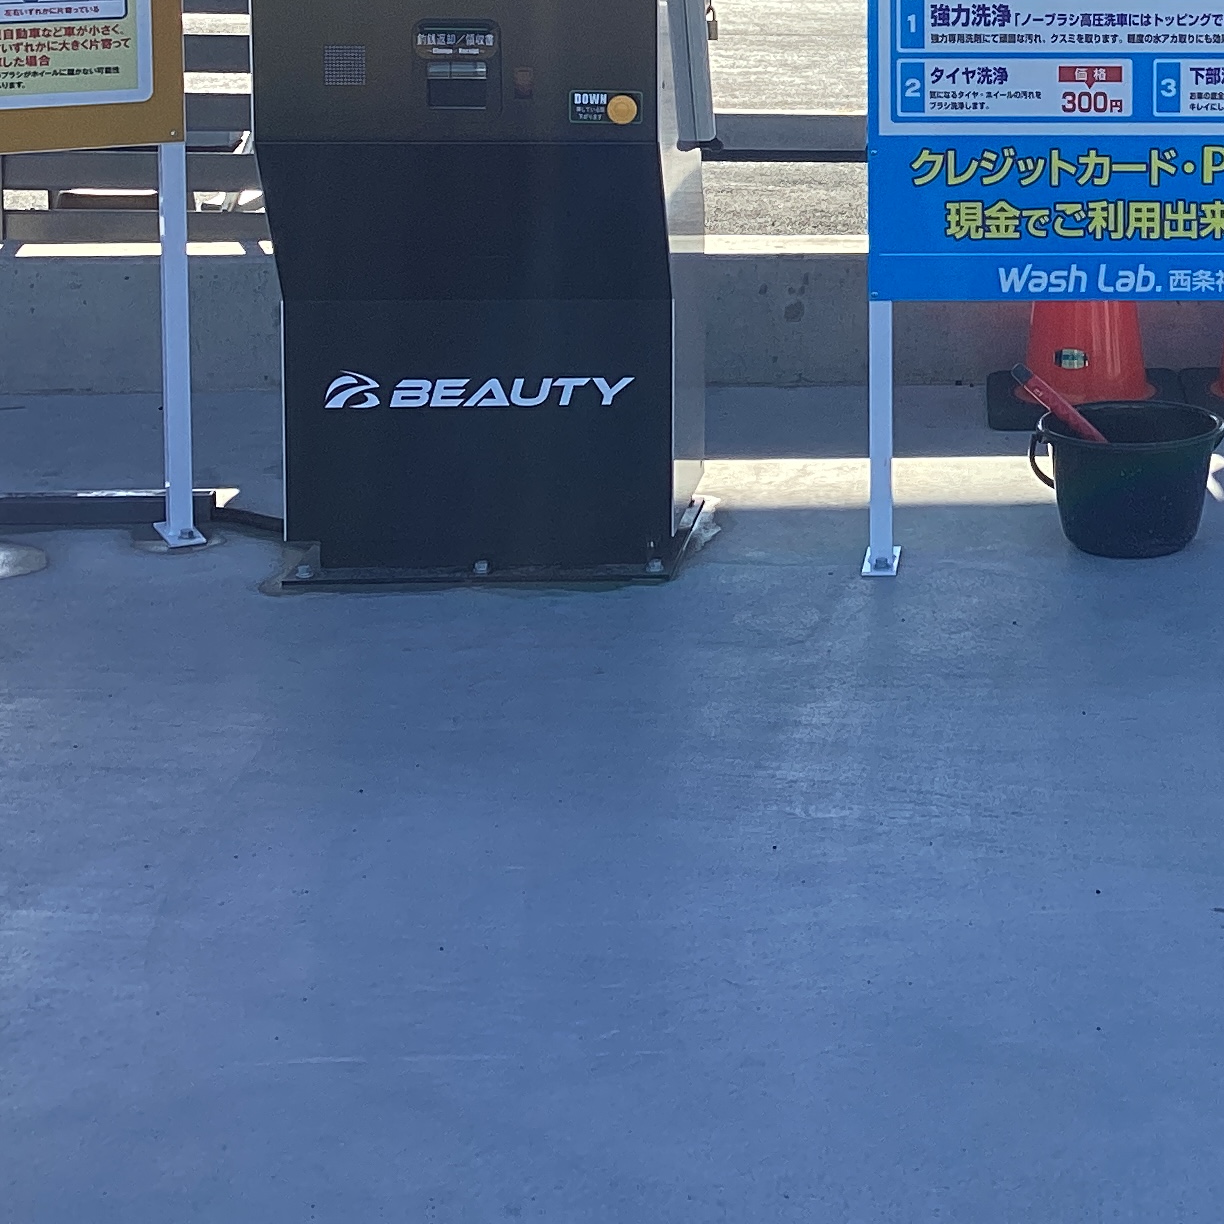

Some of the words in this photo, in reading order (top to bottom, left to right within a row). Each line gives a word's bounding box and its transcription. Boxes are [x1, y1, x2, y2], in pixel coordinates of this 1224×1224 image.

[906, 13, 917, 33] 1
[930, 3, 1012, 28] 強力洗浄
[0, 38, 132, 53] いずれかに大きく片寄って
[0, 55, 51, 69] した場合
[930, 66, 1009, 86] タイヤ洗浄
[1075, 68, 1107, 81] 価格
[904, 78, 921, 98] 2
[1160, 78, 1177, 98] 3
[574, 93, 607, 105] DOWN
[1061, 91, 1124, 114] 300円
[998, 264, 1087, 294] Wash
[1098, 263, 1163, 294] Lab.
[389, 376, 635, 407] BEAUTY
